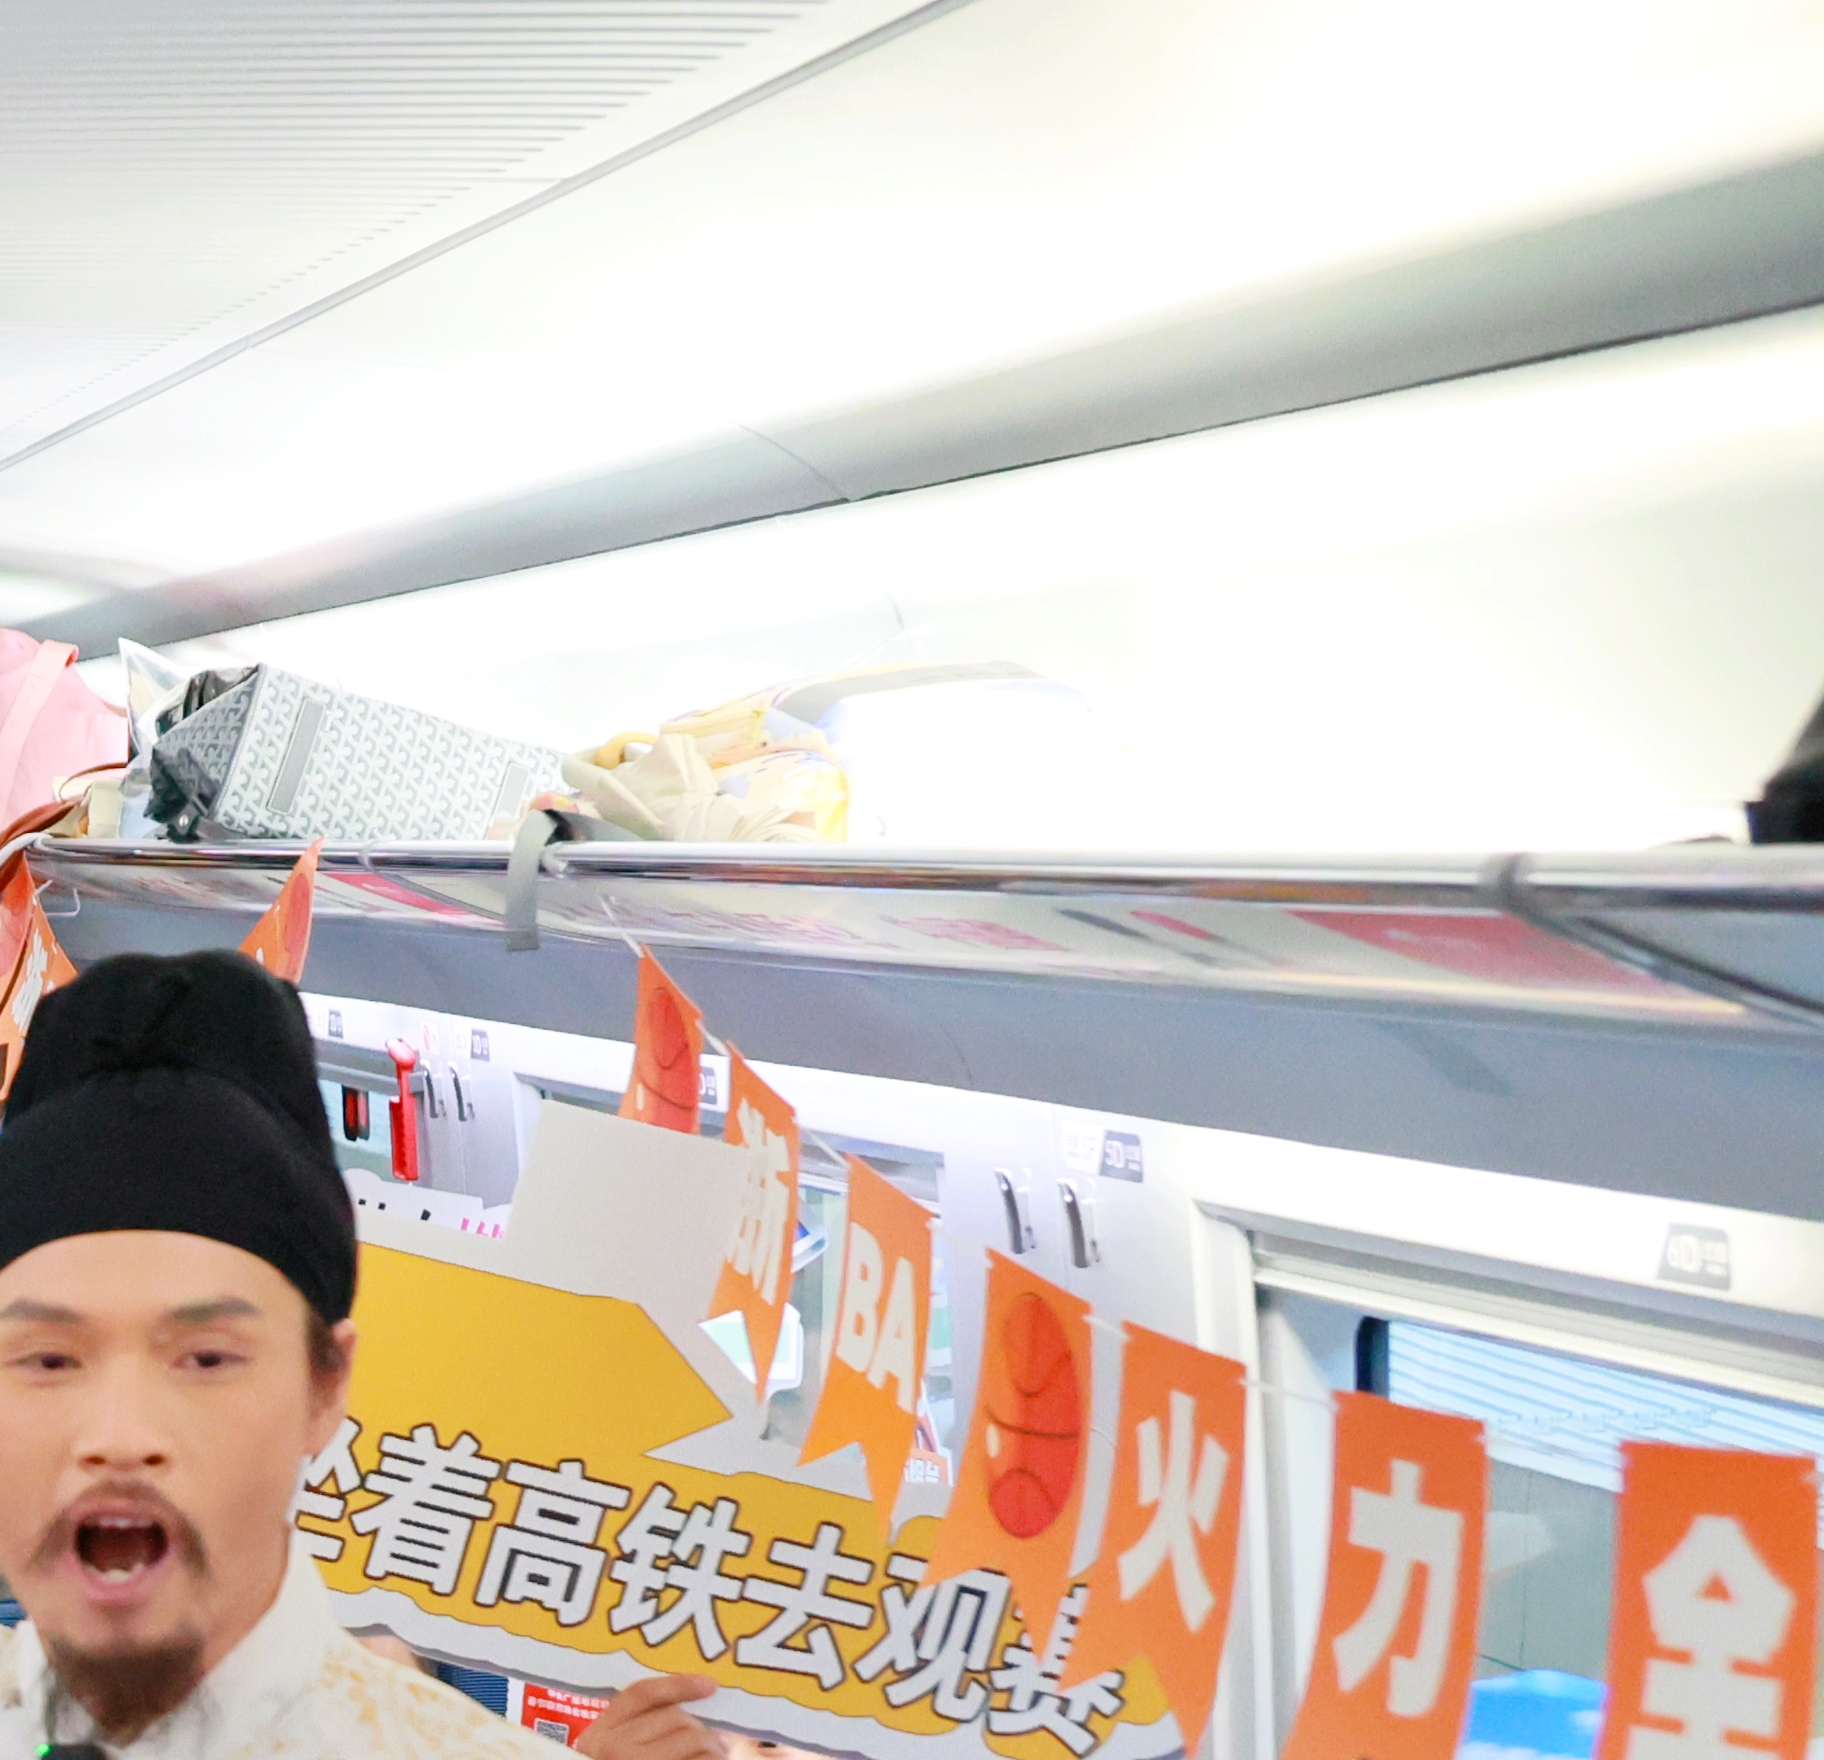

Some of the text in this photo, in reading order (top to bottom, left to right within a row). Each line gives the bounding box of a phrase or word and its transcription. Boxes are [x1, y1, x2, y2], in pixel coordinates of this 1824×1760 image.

[836, 1221, 917, 1415] BA
[1120, 1390, 1232, 1636] 火
[1332, 1458, 1464, 1720] 力
